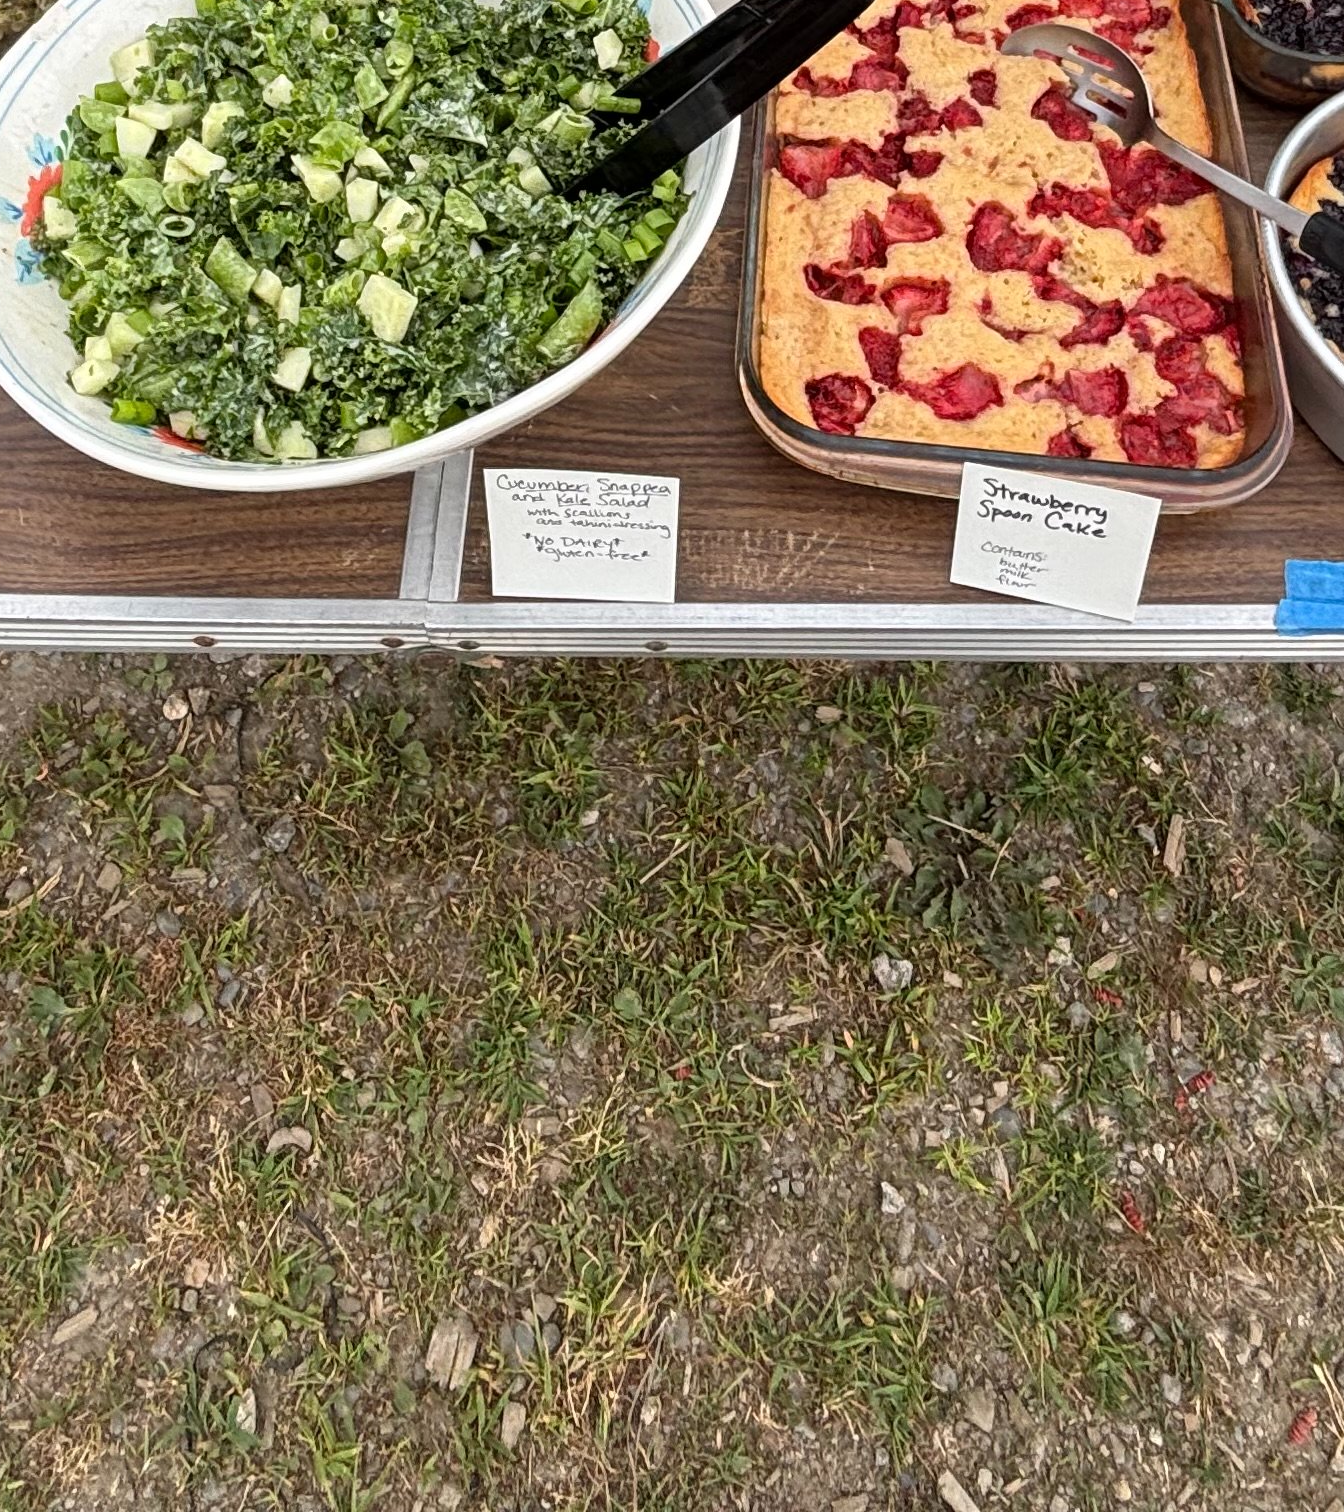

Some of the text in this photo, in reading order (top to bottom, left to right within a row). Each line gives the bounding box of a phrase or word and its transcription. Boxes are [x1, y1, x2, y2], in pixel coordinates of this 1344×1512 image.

[512, 490, 651, 508] and Kale Salad
[983, 477, 1108, 525] Strawberry
[527, 507, 560, 517] with
[977, 499, 1107, 538] Spoon Cake
[999, 558, 1049, 574] butter
[999, 568, 1032, 580] milk
[995, 575, 1037, 588] flour
